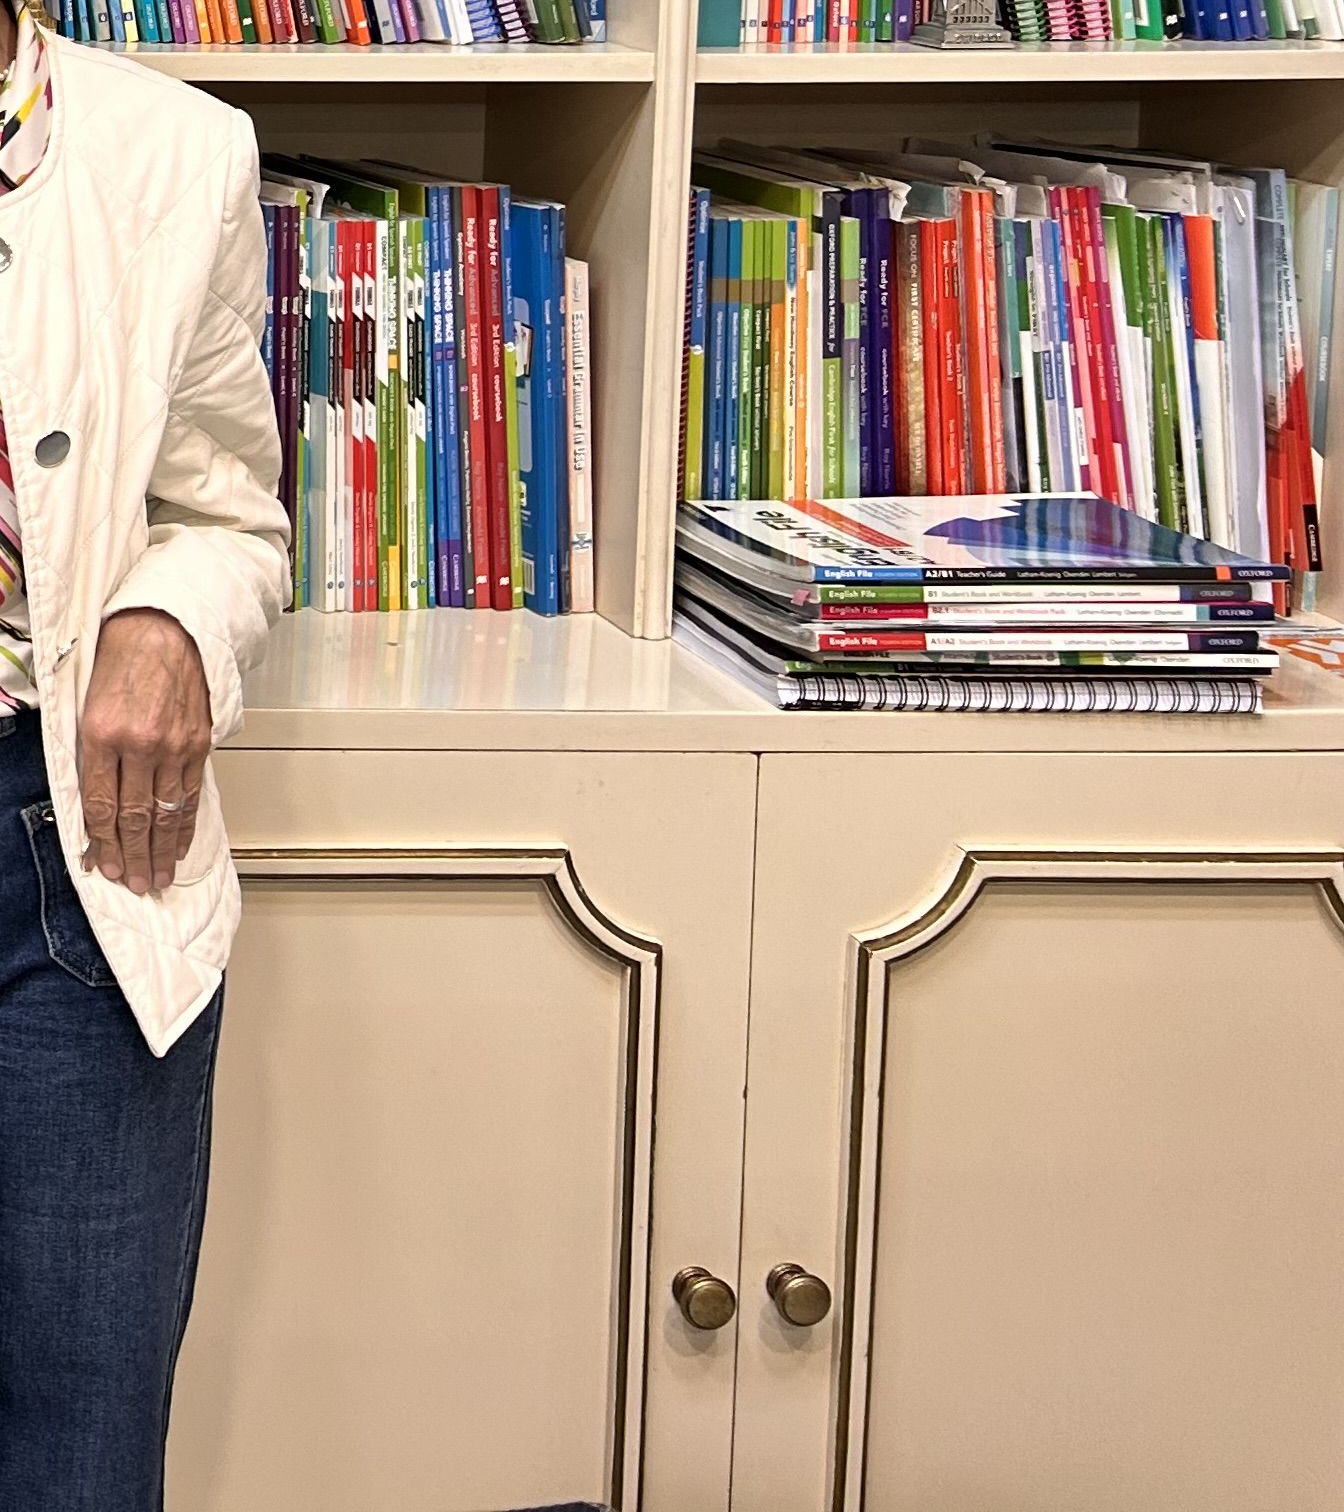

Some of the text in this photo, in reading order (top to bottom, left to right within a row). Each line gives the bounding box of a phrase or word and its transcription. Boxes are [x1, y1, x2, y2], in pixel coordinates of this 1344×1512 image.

[487, 218, 498, 249] Ready
[489, 251, 499, 266] for
[443, 268, 454, 343] THINKING SPACE
[492, 340, 501, 368] Edition
[572, 311, 585, 370] Essential
[494, 374, 503, 422] coursebook
[824, 569, 1006, 578] English File A2/B1 Teacher's Guide
[829, 590, 859, 599] English
[861, 590, 876, 598] File
[829, 637, 860, 646] English
[862, 637, 877, 645] File
